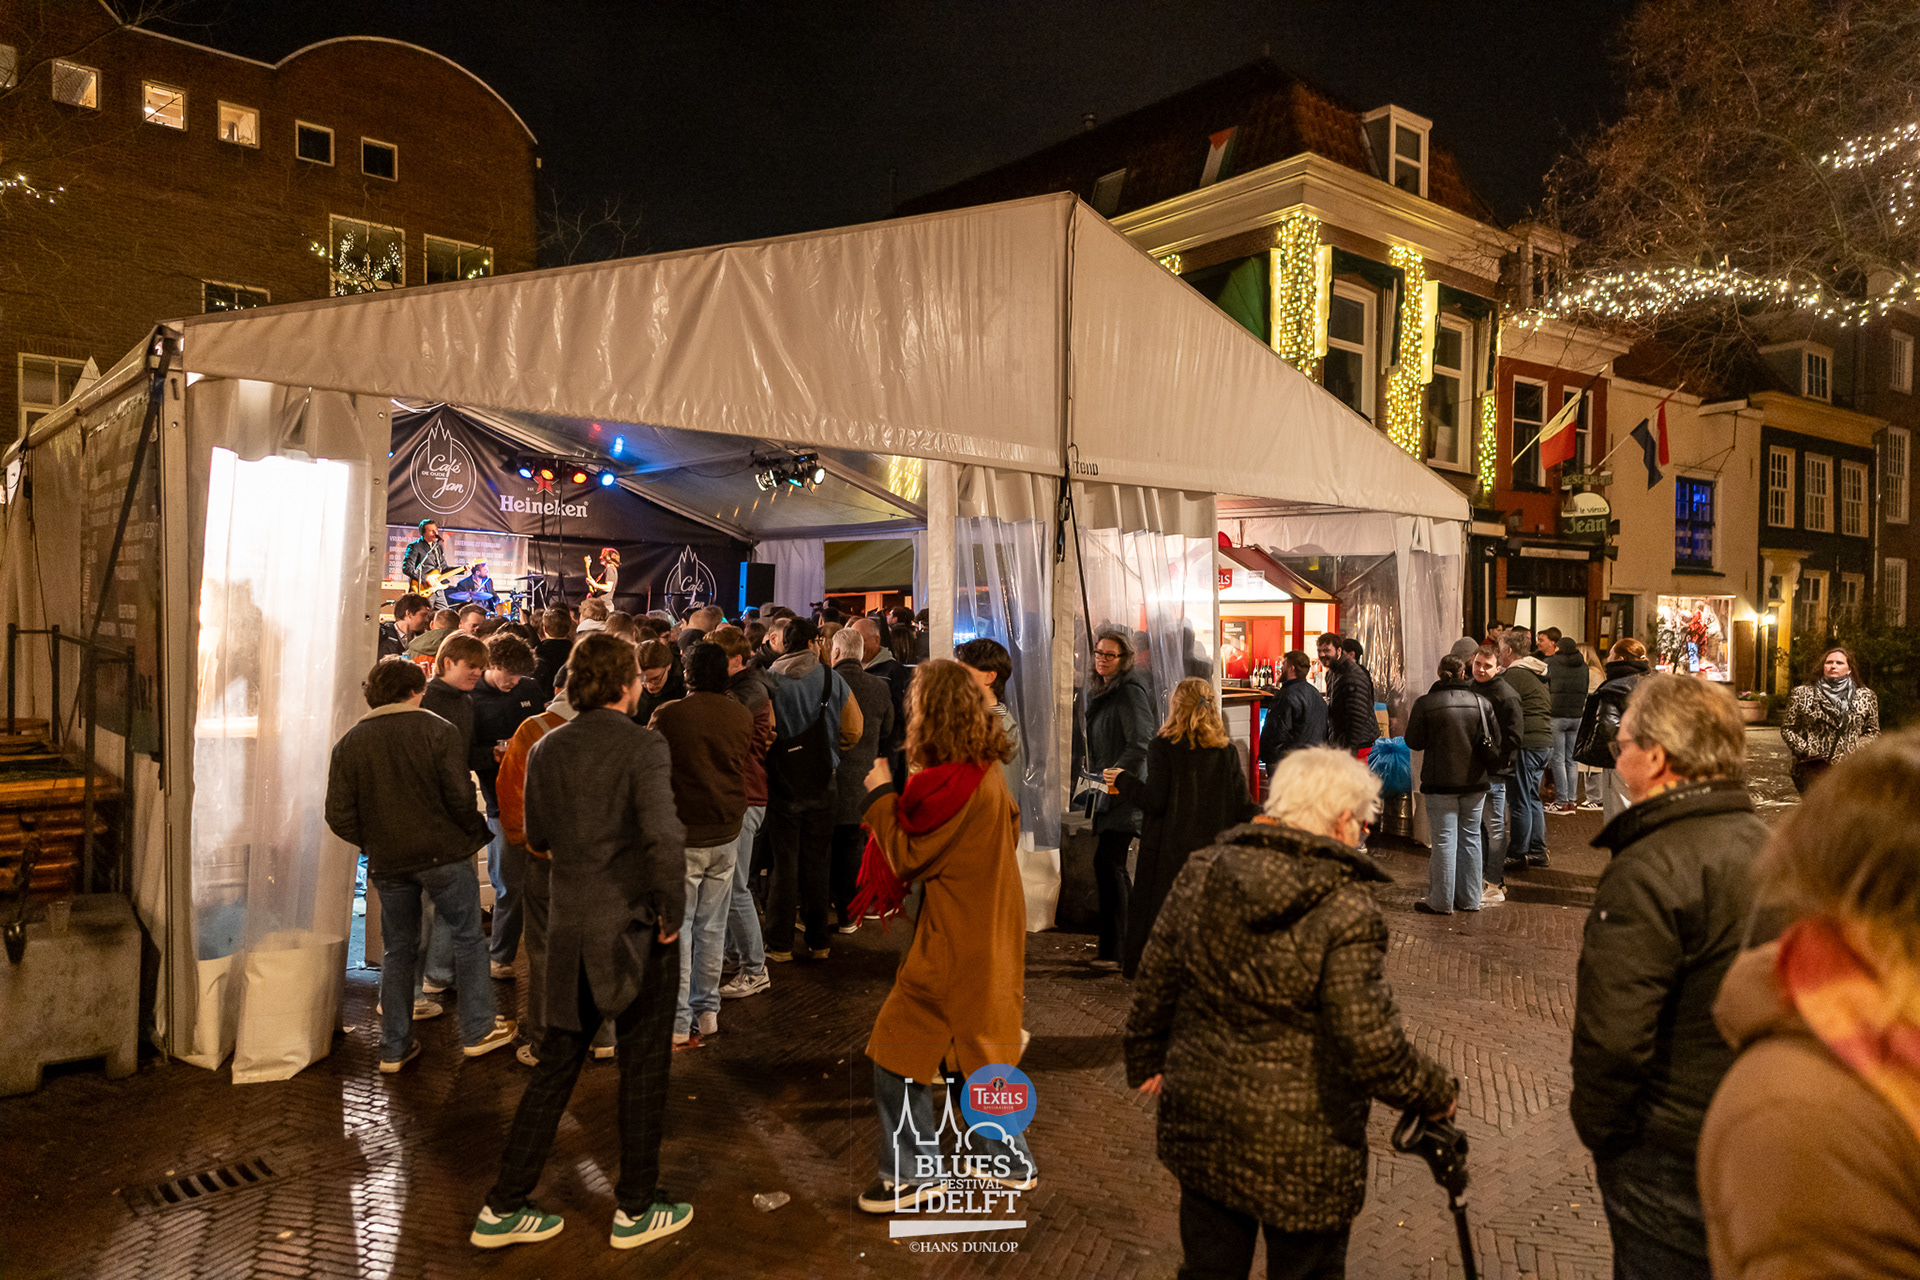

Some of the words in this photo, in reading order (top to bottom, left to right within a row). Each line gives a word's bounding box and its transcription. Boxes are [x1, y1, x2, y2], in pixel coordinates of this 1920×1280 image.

[429, 454, 461, 476] Café
[431, 477, 464, 499] Jan
[499, 494, 588, 518] Heineken
[1563, 515, 1607, 534] Jean
